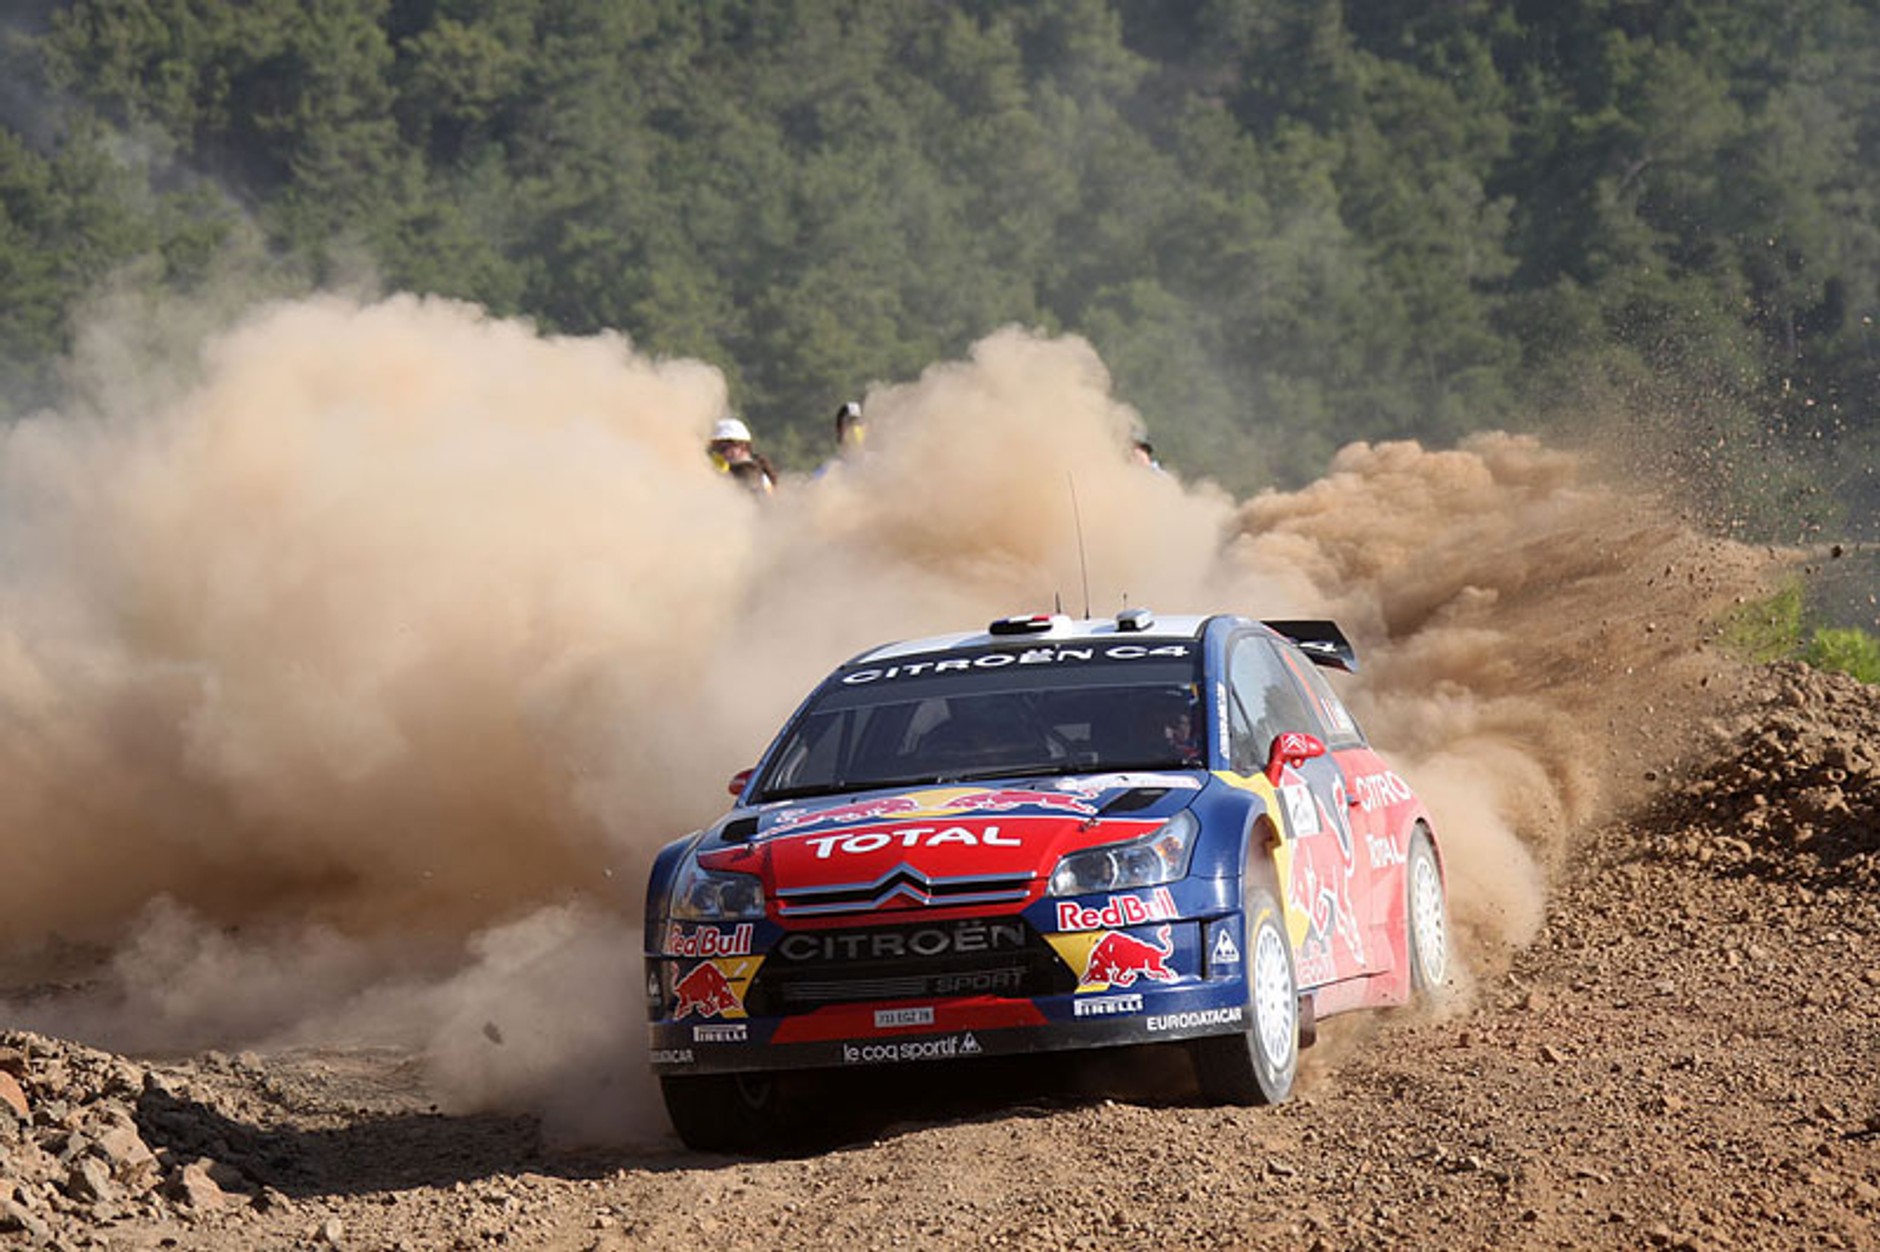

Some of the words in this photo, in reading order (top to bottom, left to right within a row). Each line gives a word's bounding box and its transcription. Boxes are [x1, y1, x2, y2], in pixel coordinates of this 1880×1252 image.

[842, 645, 1094, 684] CITROËN
[1104, 644, 1190, 660] C4
[806, 826, 1021, 859] TOTAL
[1056, 895, 1124, 932] Red
[1121, 886, 1180, 925] Bull
[699, 922, 754, 957] Bull
[779, 920, 1027, 961] CITROËN
[935, 966, 1028, 993] SPORT
[1073, 993, 1144, 1017] PIRELLI
[1146, 1007, 1242, 1031] EURODATACAR
[693, 1023, 748, 1042] PIRELLI
[843, 1041, 860, 1063] le
[861, 1043, 899, 1063] coq
[899, 1035, 958, 1060] sportif
